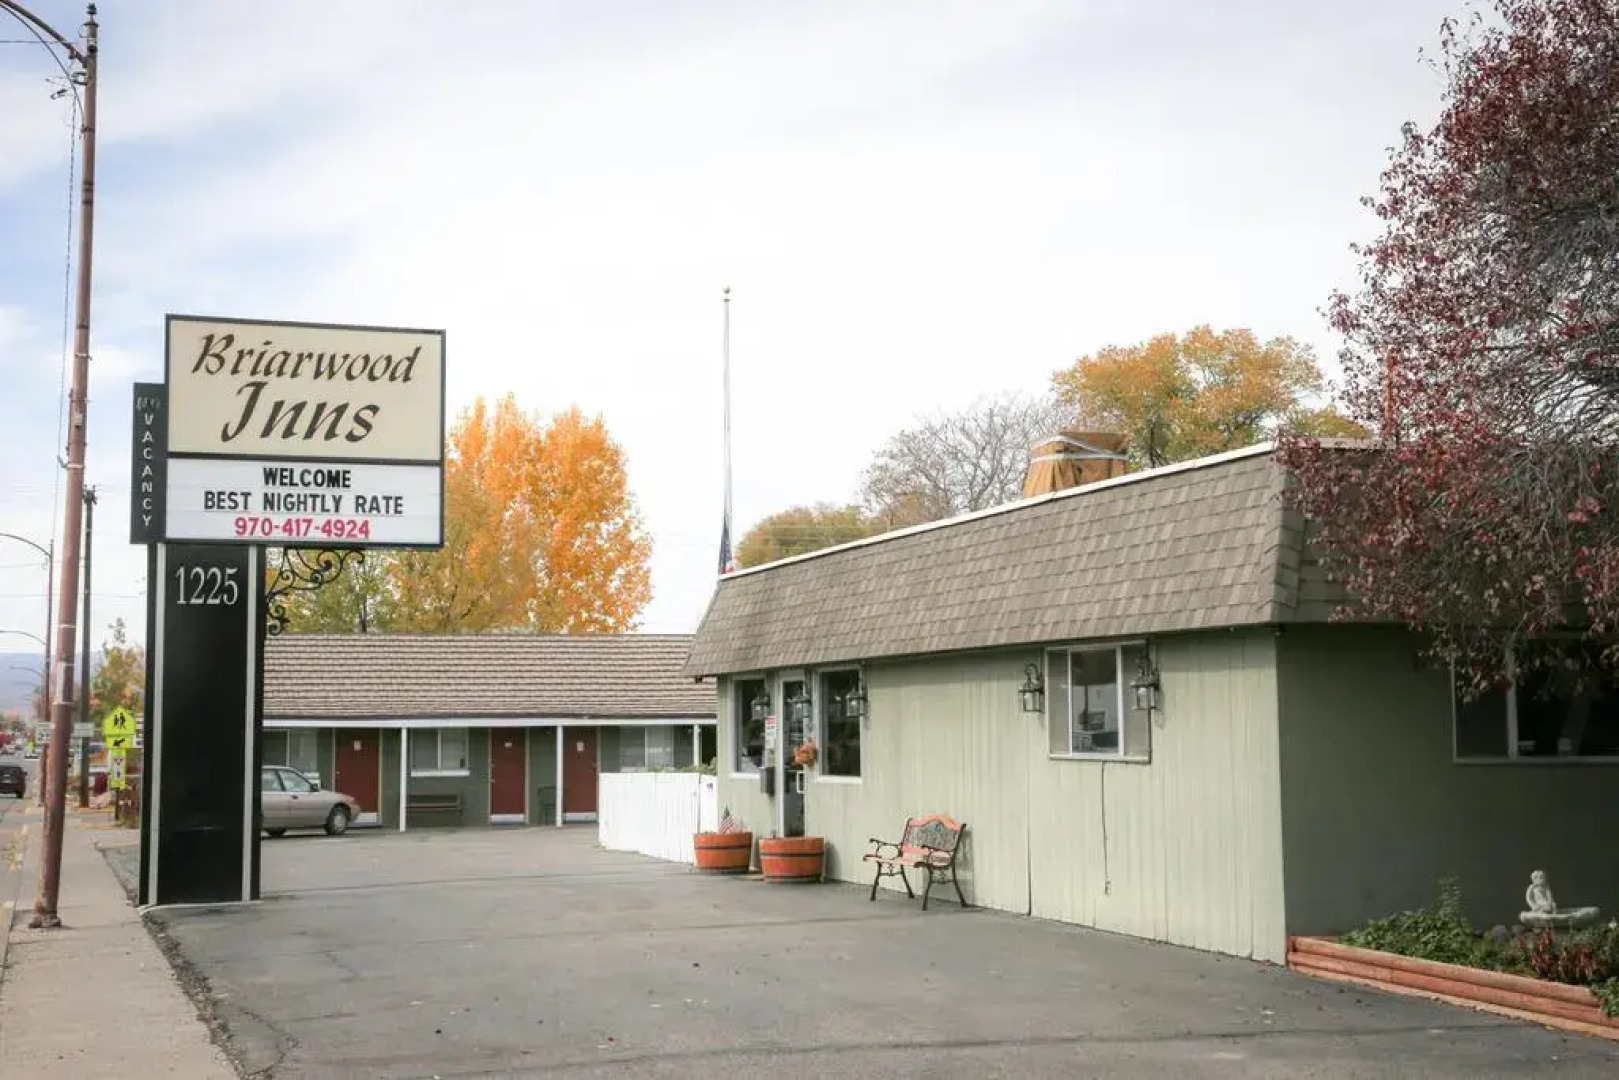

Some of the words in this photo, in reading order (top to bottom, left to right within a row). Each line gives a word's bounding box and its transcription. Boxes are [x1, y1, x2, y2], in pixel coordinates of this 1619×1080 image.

[192, 333, 422, 382] Briarwood
[220, 381, 380, 443] Inns
[141, 412, 154, 527] VACANCY
[263, 467, 351, 489] WELCOME
[204, 491, 251, 511] BEST
[263, 492, 342, 513] NIGHTLY
[355, 495, 403, 515] RATE
[235, 517, 370, 538] 970-417-4924
[175, 566, 238, 605] 1225
